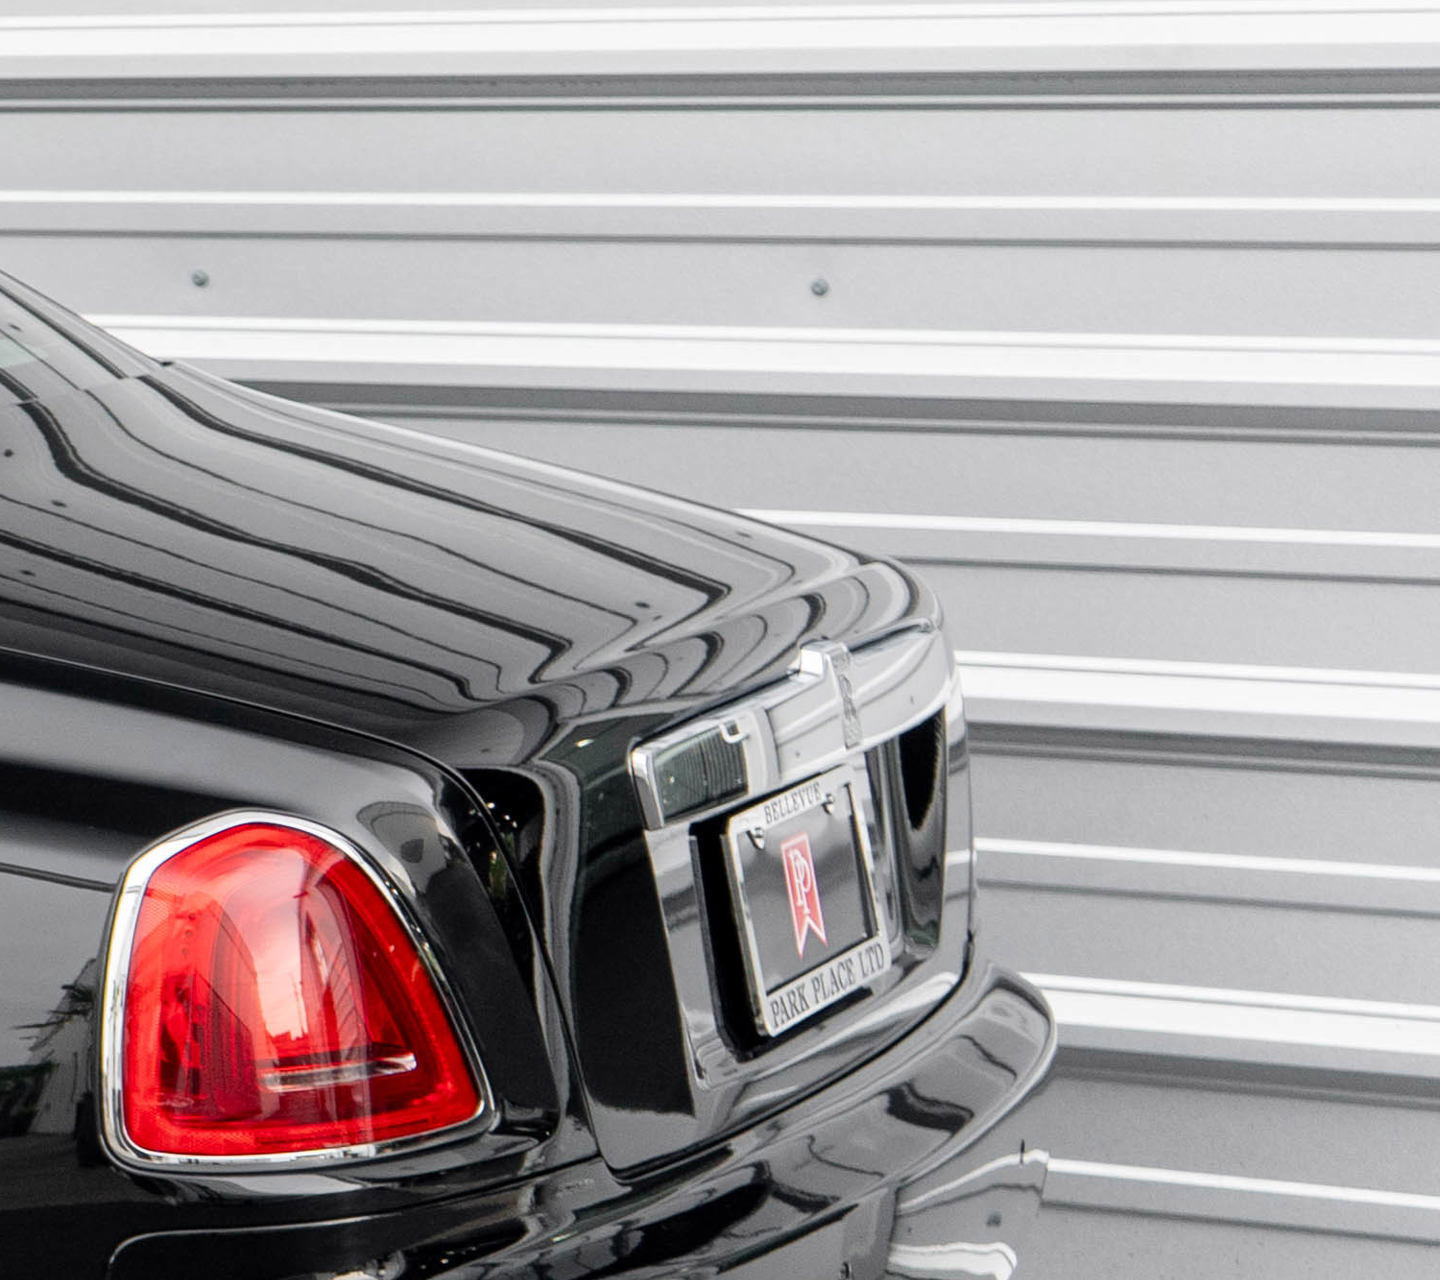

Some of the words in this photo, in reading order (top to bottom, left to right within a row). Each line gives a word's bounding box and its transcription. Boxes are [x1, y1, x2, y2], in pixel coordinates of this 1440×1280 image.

[763, 780, 822, 825] BELLEVUE
[769, 983, 810, 1028] PARK
[811, 957, 856, 1004] PLACE
[857, 942, 885, 979] LTD
